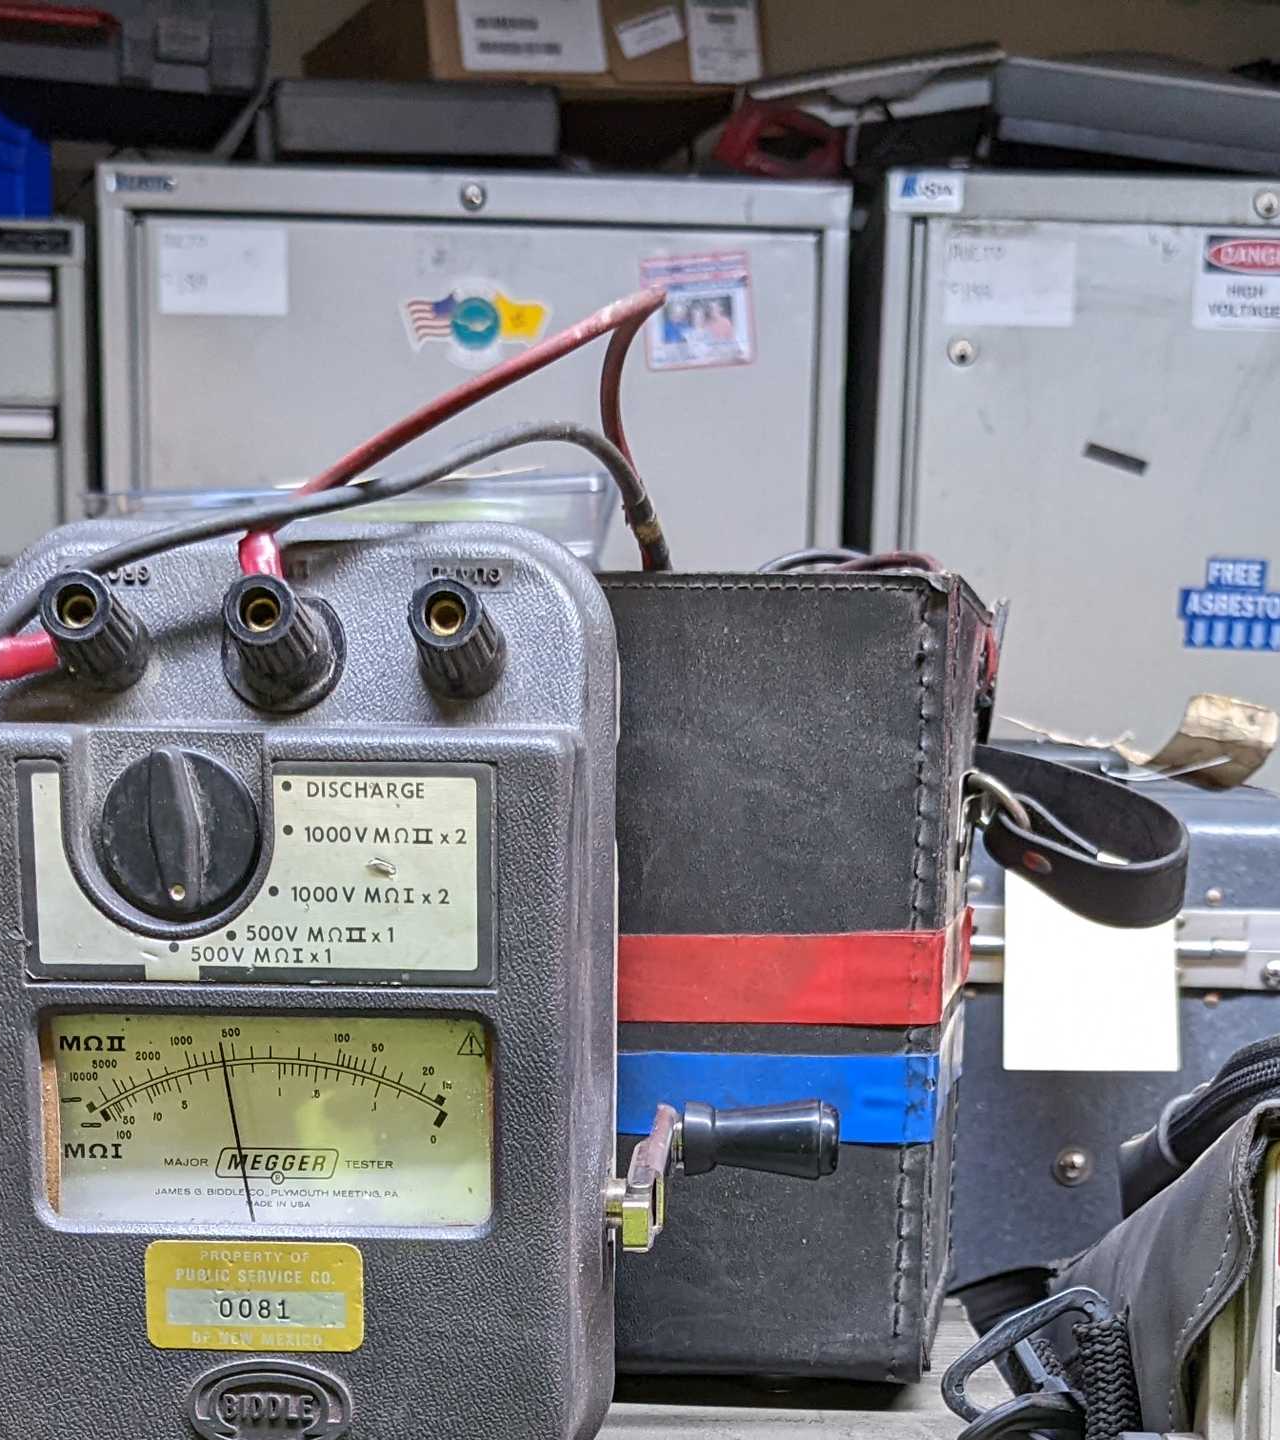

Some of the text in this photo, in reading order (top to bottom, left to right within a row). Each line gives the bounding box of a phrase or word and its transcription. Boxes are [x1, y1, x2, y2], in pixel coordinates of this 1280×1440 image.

[1226, 283, 1264, 298] HIGH
[1208, 561, 1262, 587] FREE
[306, 781, 426, 800] DISCHARGE
[245, 925, 299, 942] 500V
[191, 946, 245, 963] 500V
[135, 1027, 435, 1076] 2000 1000 500 100 50 20
[164, 1154, 394, 1172] MAJOR MEGGER TESTER
[154, 1188, 329, 1198] JAMES BIDDLE PLYMOUTH
[274, 1200, 311, 1208] IN USA
[199, 1250, 311, 1264] PROPERTY OF
[175, 1268, 336, 1285] PUBLIC SERVICE CO.
[218, 1299, 291, 1320] 0081
[191, 1331, 322, 1346] OF NEW MEXICO
[222, 1393, 315, 1424] BIDDLE
